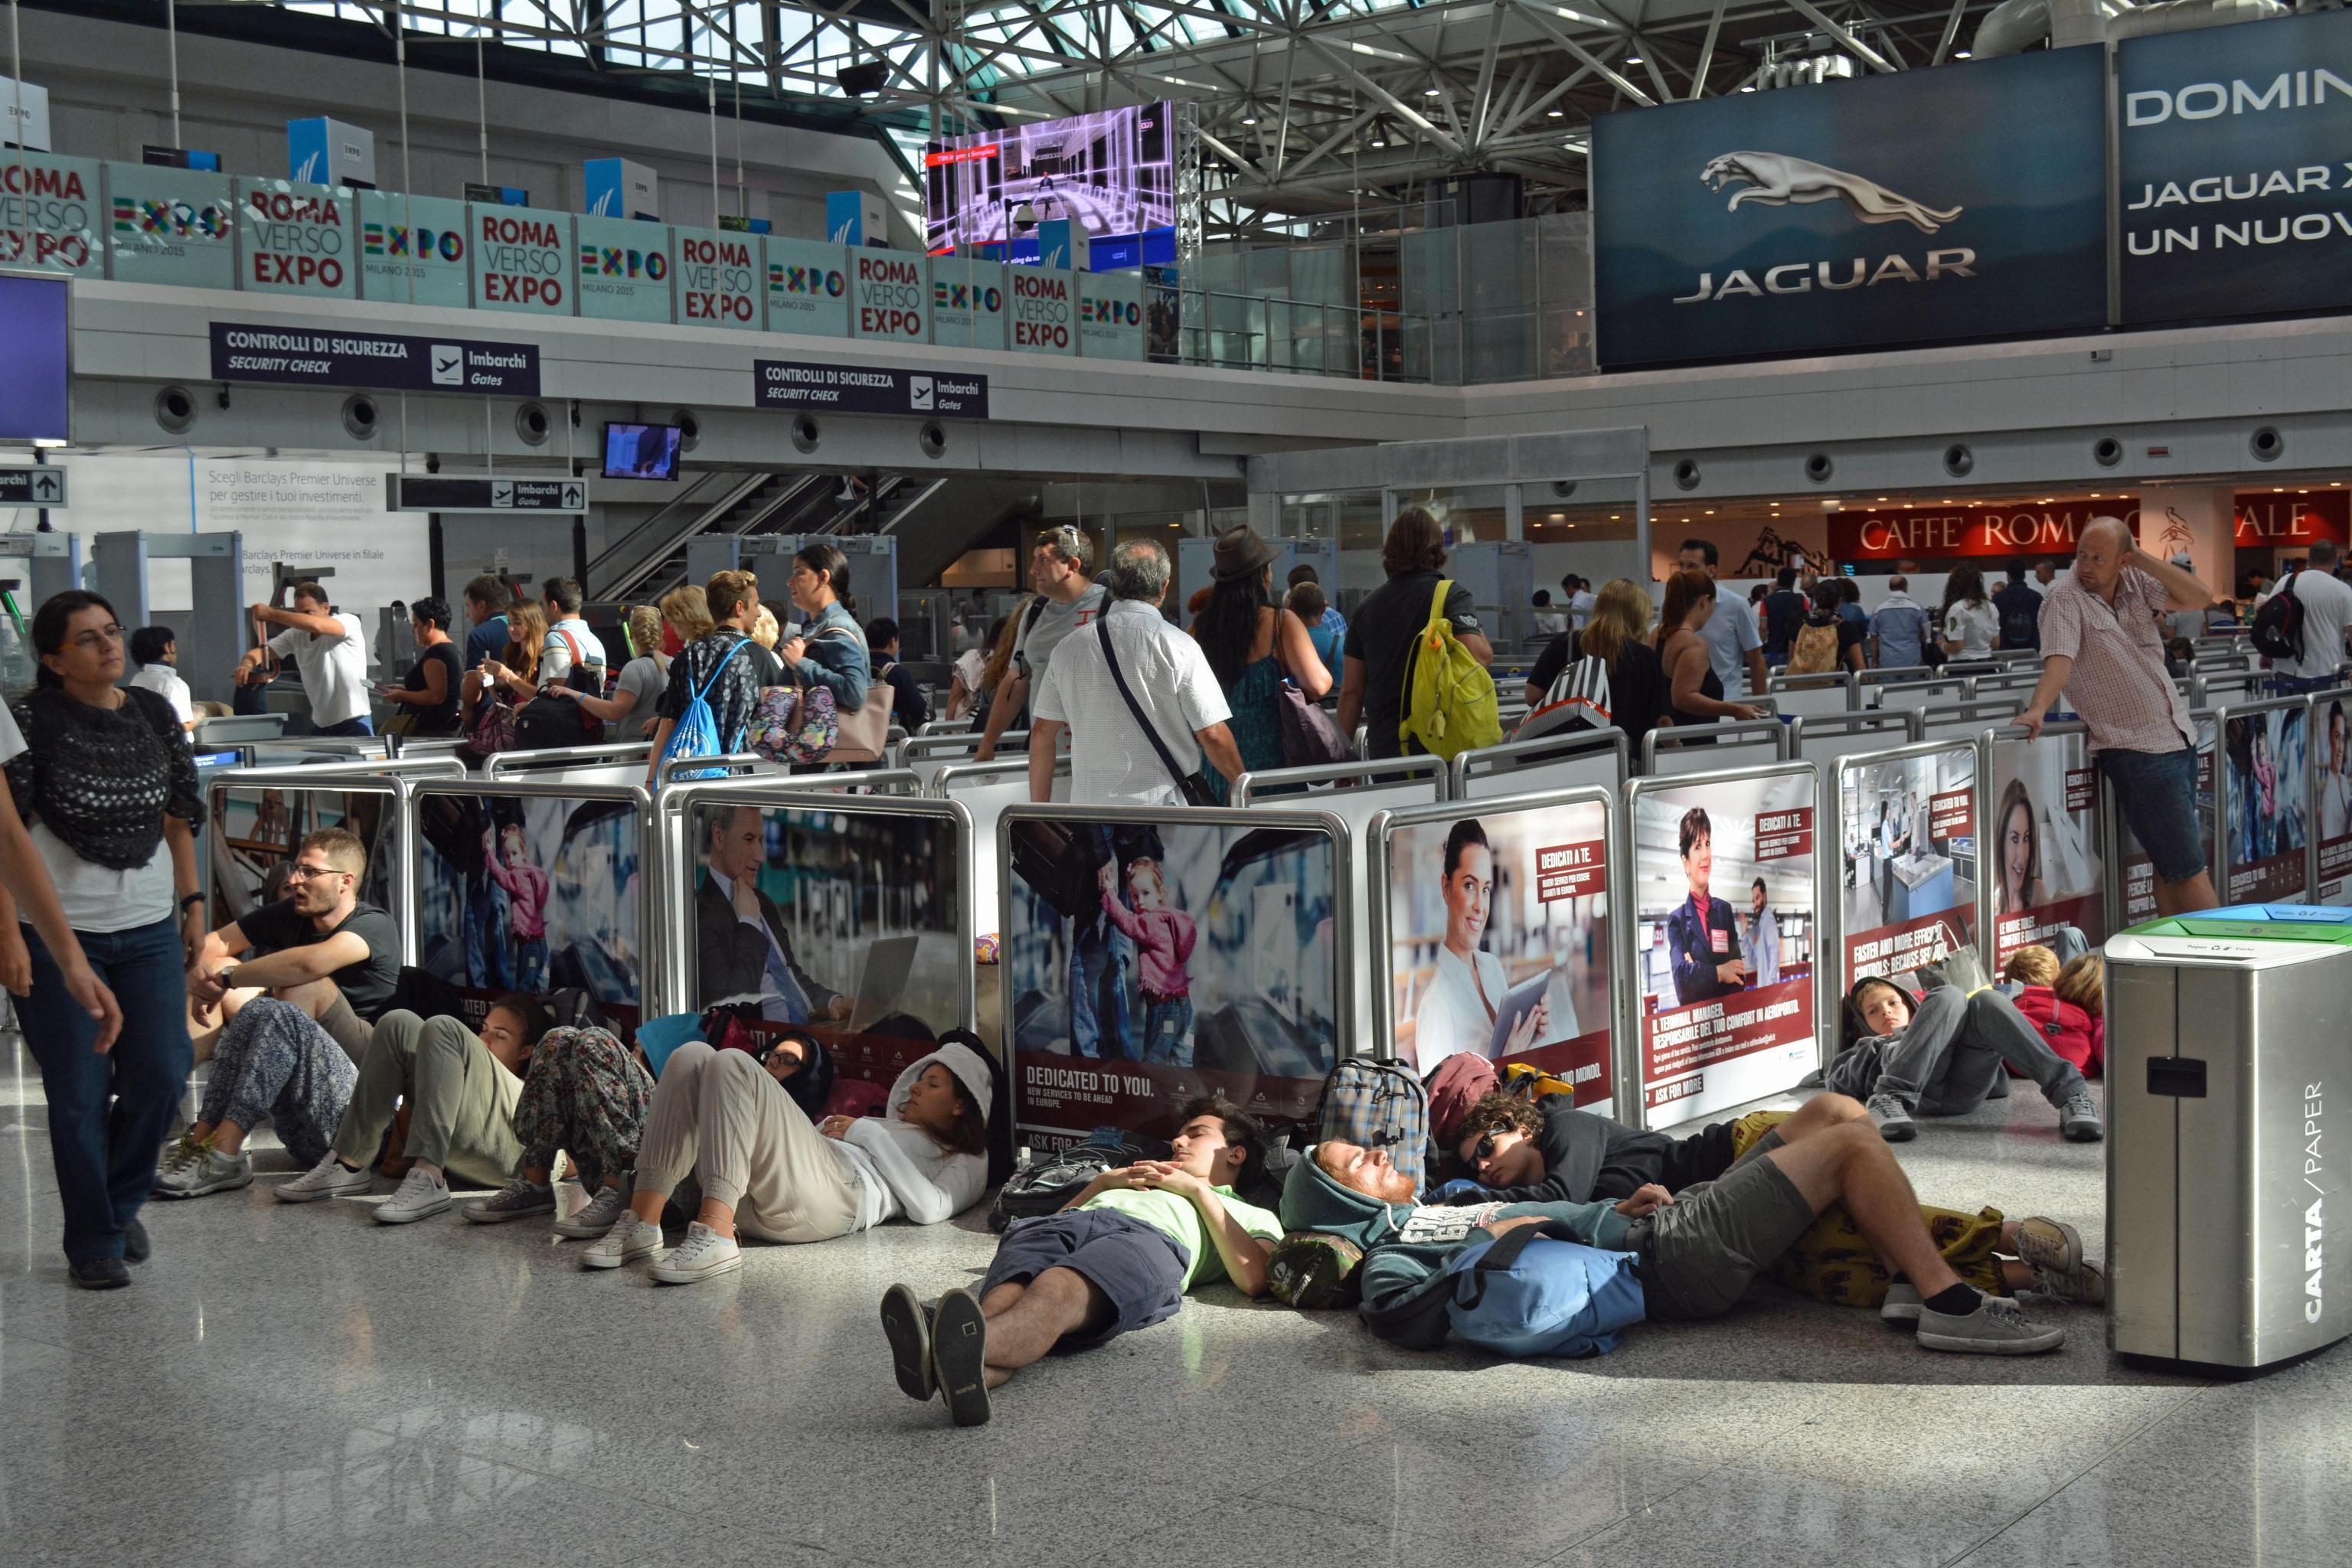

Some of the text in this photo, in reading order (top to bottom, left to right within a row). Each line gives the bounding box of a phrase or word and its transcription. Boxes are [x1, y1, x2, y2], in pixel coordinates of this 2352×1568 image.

[0, 165, 87, 201] OMA
[2128, 165, 2331, 210] JAGUAR
[113, 196, 232, 240] EXPO
[250, 191, 341, 227] ROMA
[253, 222, 342, 255] VERSO
[364, 222, 465, 262] EXPO
[482, 216, 560, 249] ROMA
[2128, 226, 2199, 256] UN
[116, 242, 185, 257] MILANO 2015
[485, 244, 561, 276] VERSO
[580, 244, 668, 281] EXPO
[683, 238, 752, 269] ROMA
[253, 252, 344, 288] EXPO
[365, 264, 403, 276] MILANO
[684, 264, 753, 293] VERSO
[769, 263, 845, 298] EXPO
[859, 257, 920, 286] ROMA
[1672, 247, 1978, 304] JAGUAR
[485, 273, 563, 306] EXPO
[582, 283, 635, 296] MILANO 2015
[861, 283, 920, 309] VERSO
[934, 282, 1002, 313] EXPO
[1014, 275, 1068, 302] ROMA
[685, 291, 753, 322] EXPO
[770, 299, 816, 312] MILANO 2015
[1015, 299, 1069, 324] VERSO
[1081, 297, 1142, 327] EXPO
[861, 306, 921, 336] EXPO
[936, 315, 960, 325] MILANO
[227, 332, 408, 358] CONTROLLI DI SICUREZZA
[1015, 321, 1069, 348] EXPO
[1082, 328, 1119, 339] MILANO 2015
[228, 355, 332, 374] SECURITY CHECK
[468, 351, 527, 369] Imbarchi
[470, 372, 503, 386] Gates
[766, 367, 894, 388] CONTROLLI DI SICUREZZA
[936, 380, 979, 396] Imbarchi
[767, 387, 840, 402] SECURITY CHECK
[939, 398, 962, 410] Gates
[208, 469, 377, 488] Scegli Barclays Premier Universe
[518, 484, 559, 495] Imbarchi
[209, 491, 228, 504] per
[231, 490, 268, 505] gestire
[276, 491, 297, 502] tuoi
[299, 492, 365, 503] investimenti.
[518, 497, 541, 507] Gates
[1860, 517, 1964, 551] CAFFE'
[242, 549, 384, 562] Barclays Premier Universe in filiale
[1932, 795, 1969, 812] DEDICATED TO YOU.
[1759, 813, 1802, 833] DEDICATI A TE.
[1540, 847, 1592, 870] DEDICATI A TE.
[2230, 871, 2252, 888] DEDICATED
[1999, 922, 2006, 936] LE
[2020, 915, 2036, 930] TOILET.
[1854, 931, 1913, 964] FASTER AND MORE
[1999, 932, 2021, 949] COMFORT
[2020, 930, 2025, 944] E
[1854, 949, 1919, 983] CONTROLS: BECAUSE
[1651, 1002, 1725, 1034] IL TERMINAL MANAGER.
[1652, 1024, 1700, 1051] RESPONSABILE
[1700, 1021, 1713, 1037] DEL
[1713, 1018, 1726, 1033] TUO
[1726, 1013, 1756, 1031] COMFORT
[1756, 1011, 1764, 1022] IN
[1764, 998, 1800, 1021] AEROPORTO.
[1026, 1065, 1155, 1097] DEDICATED TO YOU.
[1575, 1062, 1602, 1084] MONDO.
[1027, 1086, 1113, 1105] NEW SERVICES TO BE AHEAD
[1027, 1096, 1062, 1109] IN EUROPE.
[1655, 1076, 1703, 1104] ASK FOR MORE
[1028, 1134, 1050, 1151] ASK
[1051, 1136, 1073, 1152] FOR
